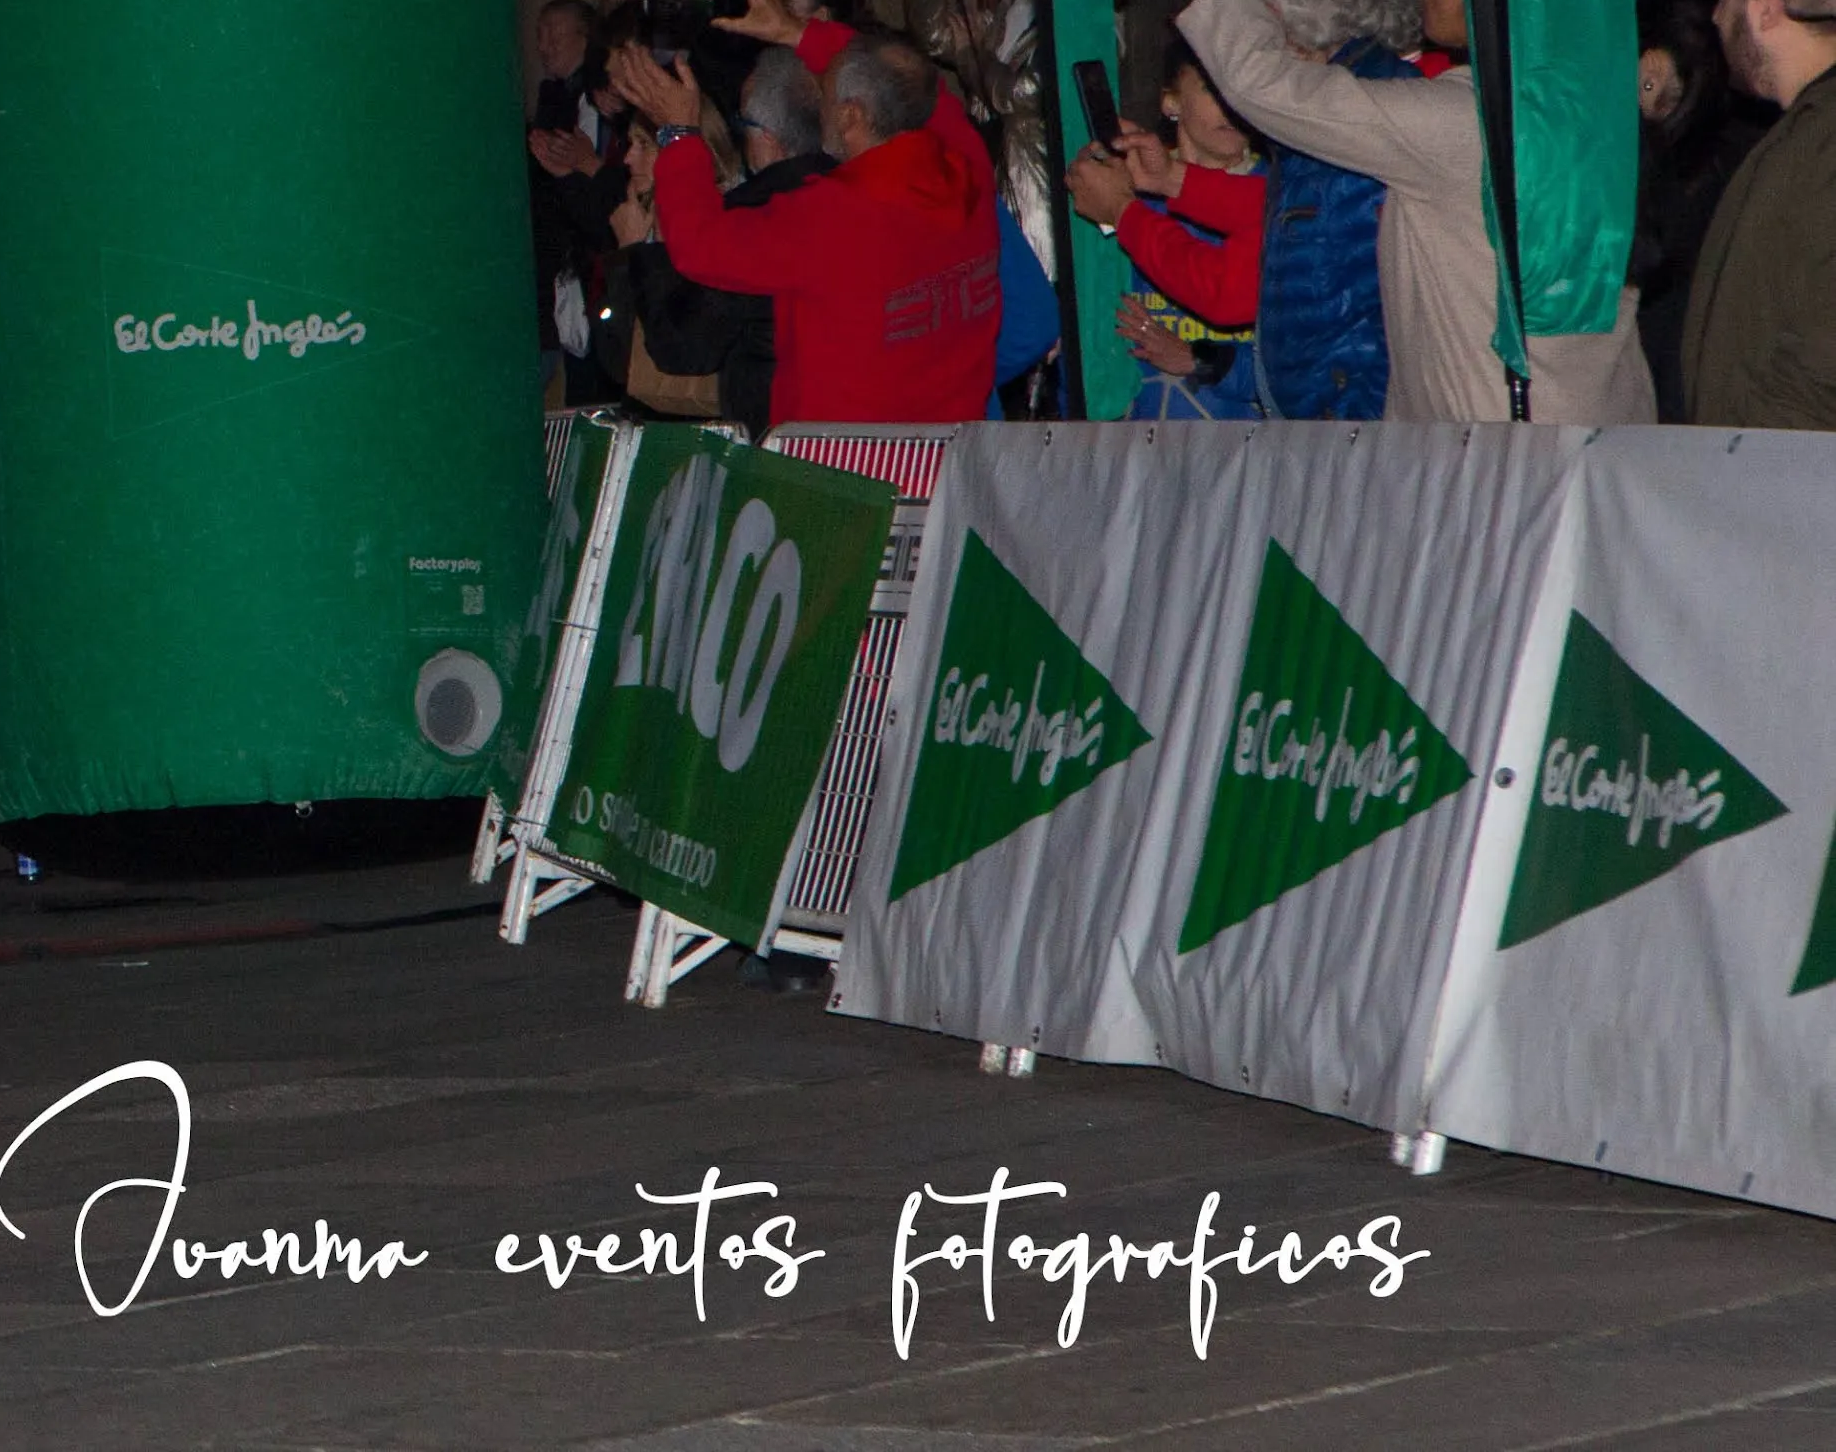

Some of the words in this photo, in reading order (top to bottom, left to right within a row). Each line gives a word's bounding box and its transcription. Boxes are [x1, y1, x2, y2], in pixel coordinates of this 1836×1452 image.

[114, 313, 151, 352] El
[152, 313, 238, 349] Corte
[243, 299, 367, 360] Inglés
[934, 666, 966, 744] El
[960, 673, 1022, 752] Corte
[1011, 659, 1105, 787] Inglés
[1233, 690, 1267, 776] El
[1261, 699, 1327, 788] Corte
[1314, 686, 1421, 826] Inglés
[1542, 736, 1576, 807] El
[1570, 744, 1636, 818] Corte
[1628, 733, 1725, 849] Inglés
